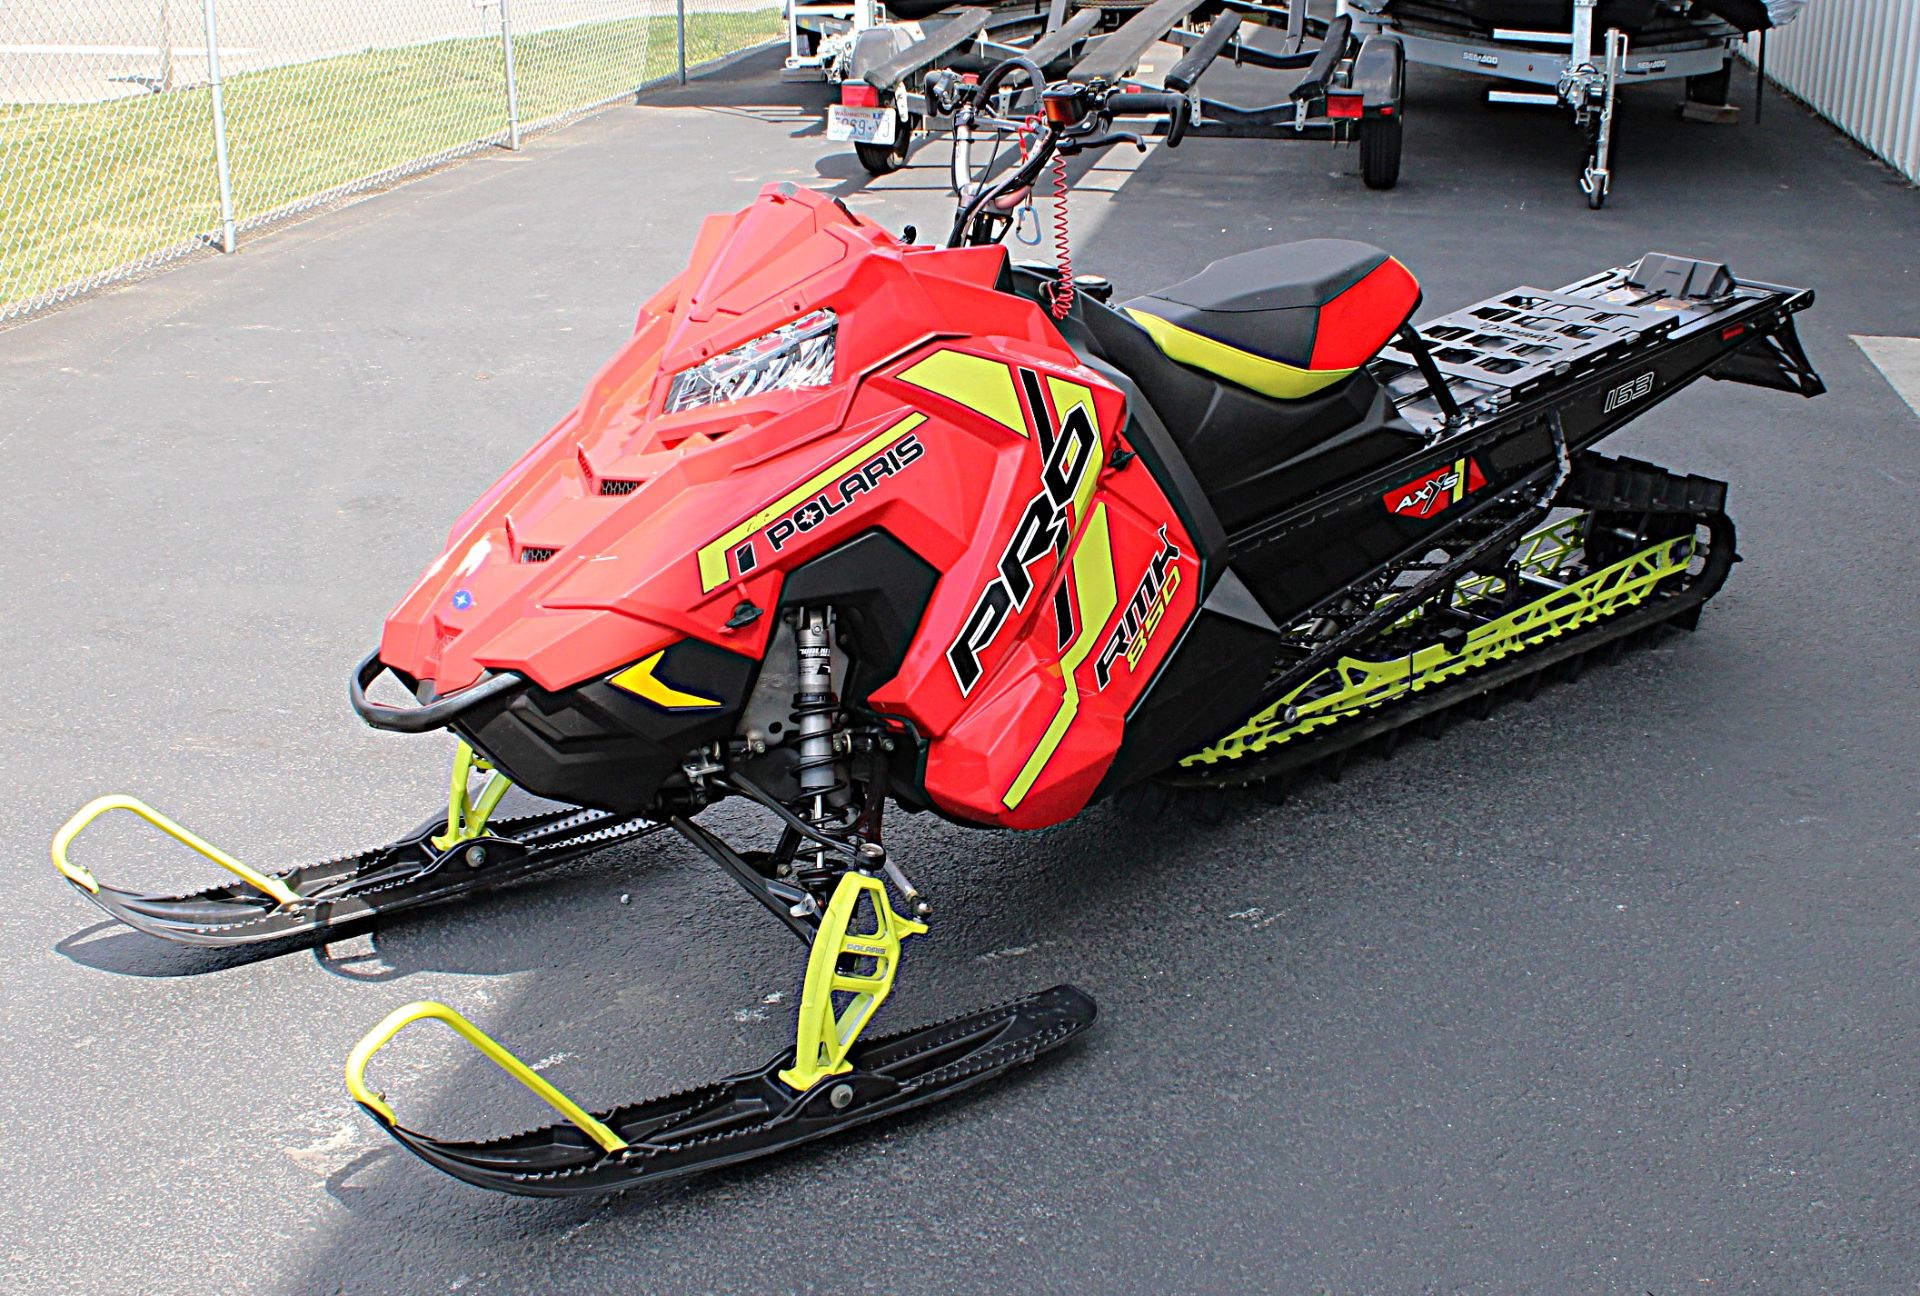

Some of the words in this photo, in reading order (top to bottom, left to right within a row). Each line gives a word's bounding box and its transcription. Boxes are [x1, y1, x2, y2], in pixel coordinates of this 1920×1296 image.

[835, 111, 871, 119] WASHINGTON
[1604, 371, 1655, 414] 163
[765, 434, 925, 552] POLARIS
[1394, 472, 1460, 515] AXYS
[946, 400, 1099, 698] PRO
[1094, 522, 1180, 692] RMK
[1126, 566, 1181, 673] 850
